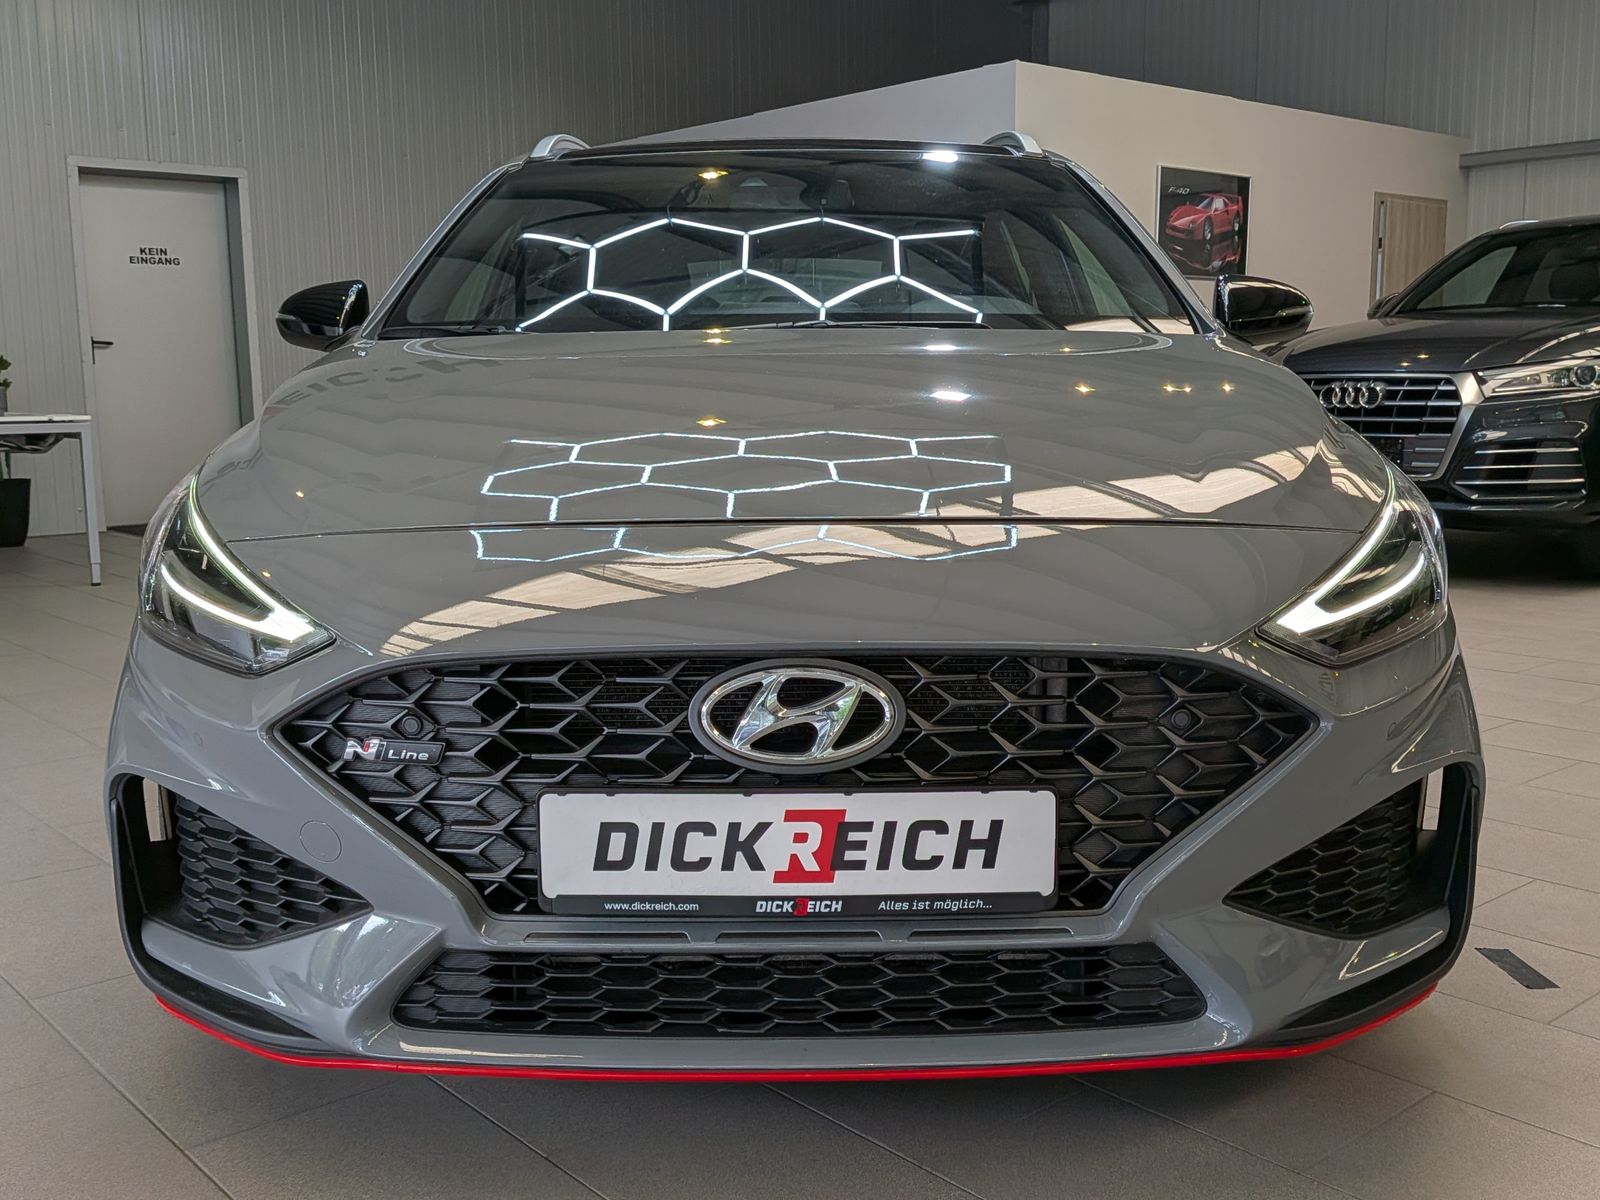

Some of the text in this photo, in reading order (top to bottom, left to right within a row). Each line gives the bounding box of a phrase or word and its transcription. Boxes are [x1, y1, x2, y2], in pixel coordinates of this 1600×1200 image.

[139, 247, 168, 256] KEIN
[129, 256, 180, 266] EINGANG
[387, 749, 429, 760] Line
[592, 812, 1004, 880] DICKREICH
[603, 901, 699, 911] www.dickreich.com
[878, 898, 993, 911] Alles ist möglich...
